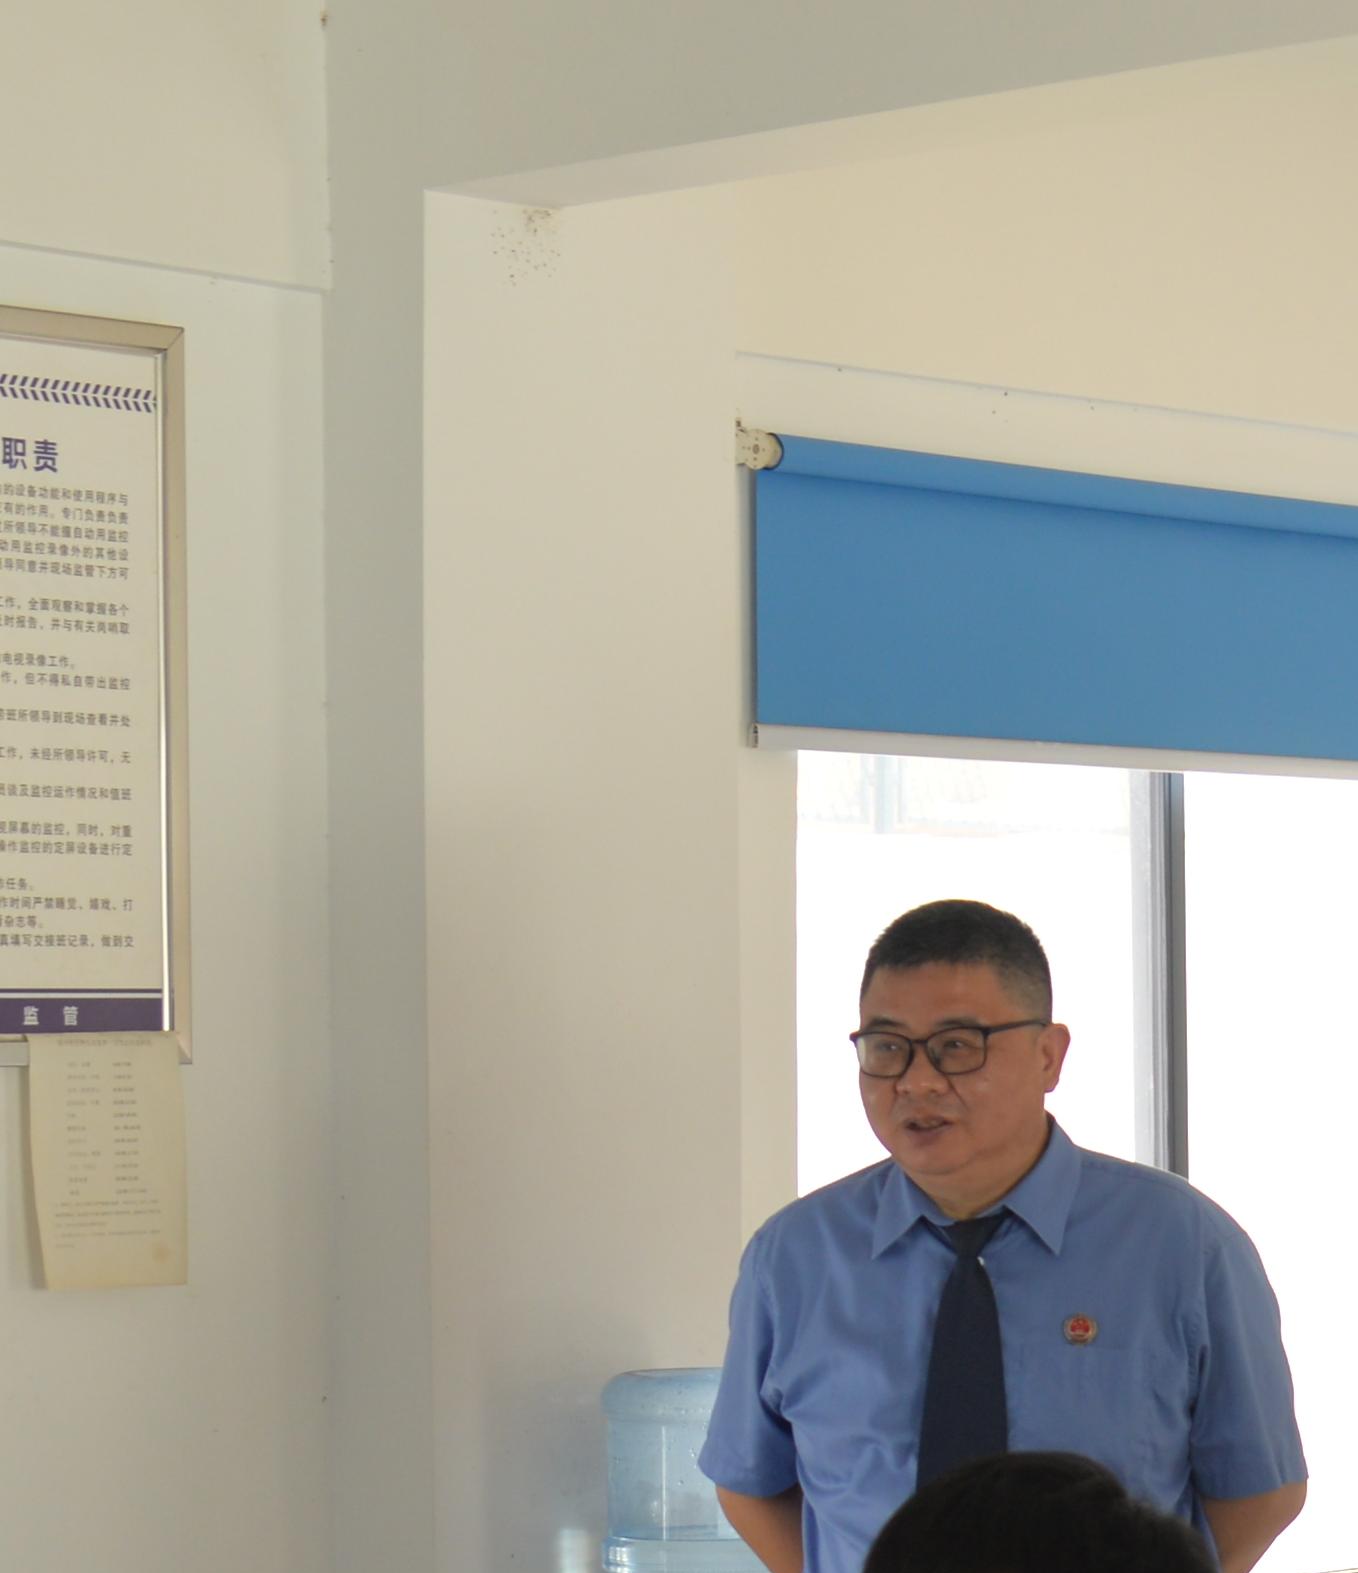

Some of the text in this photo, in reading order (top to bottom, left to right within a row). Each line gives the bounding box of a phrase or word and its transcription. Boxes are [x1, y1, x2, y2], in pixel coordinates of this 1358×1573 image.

[2, 436, 58, 473] 职责
[0, 483, 128, 506] 的设备功能和使用程序与
